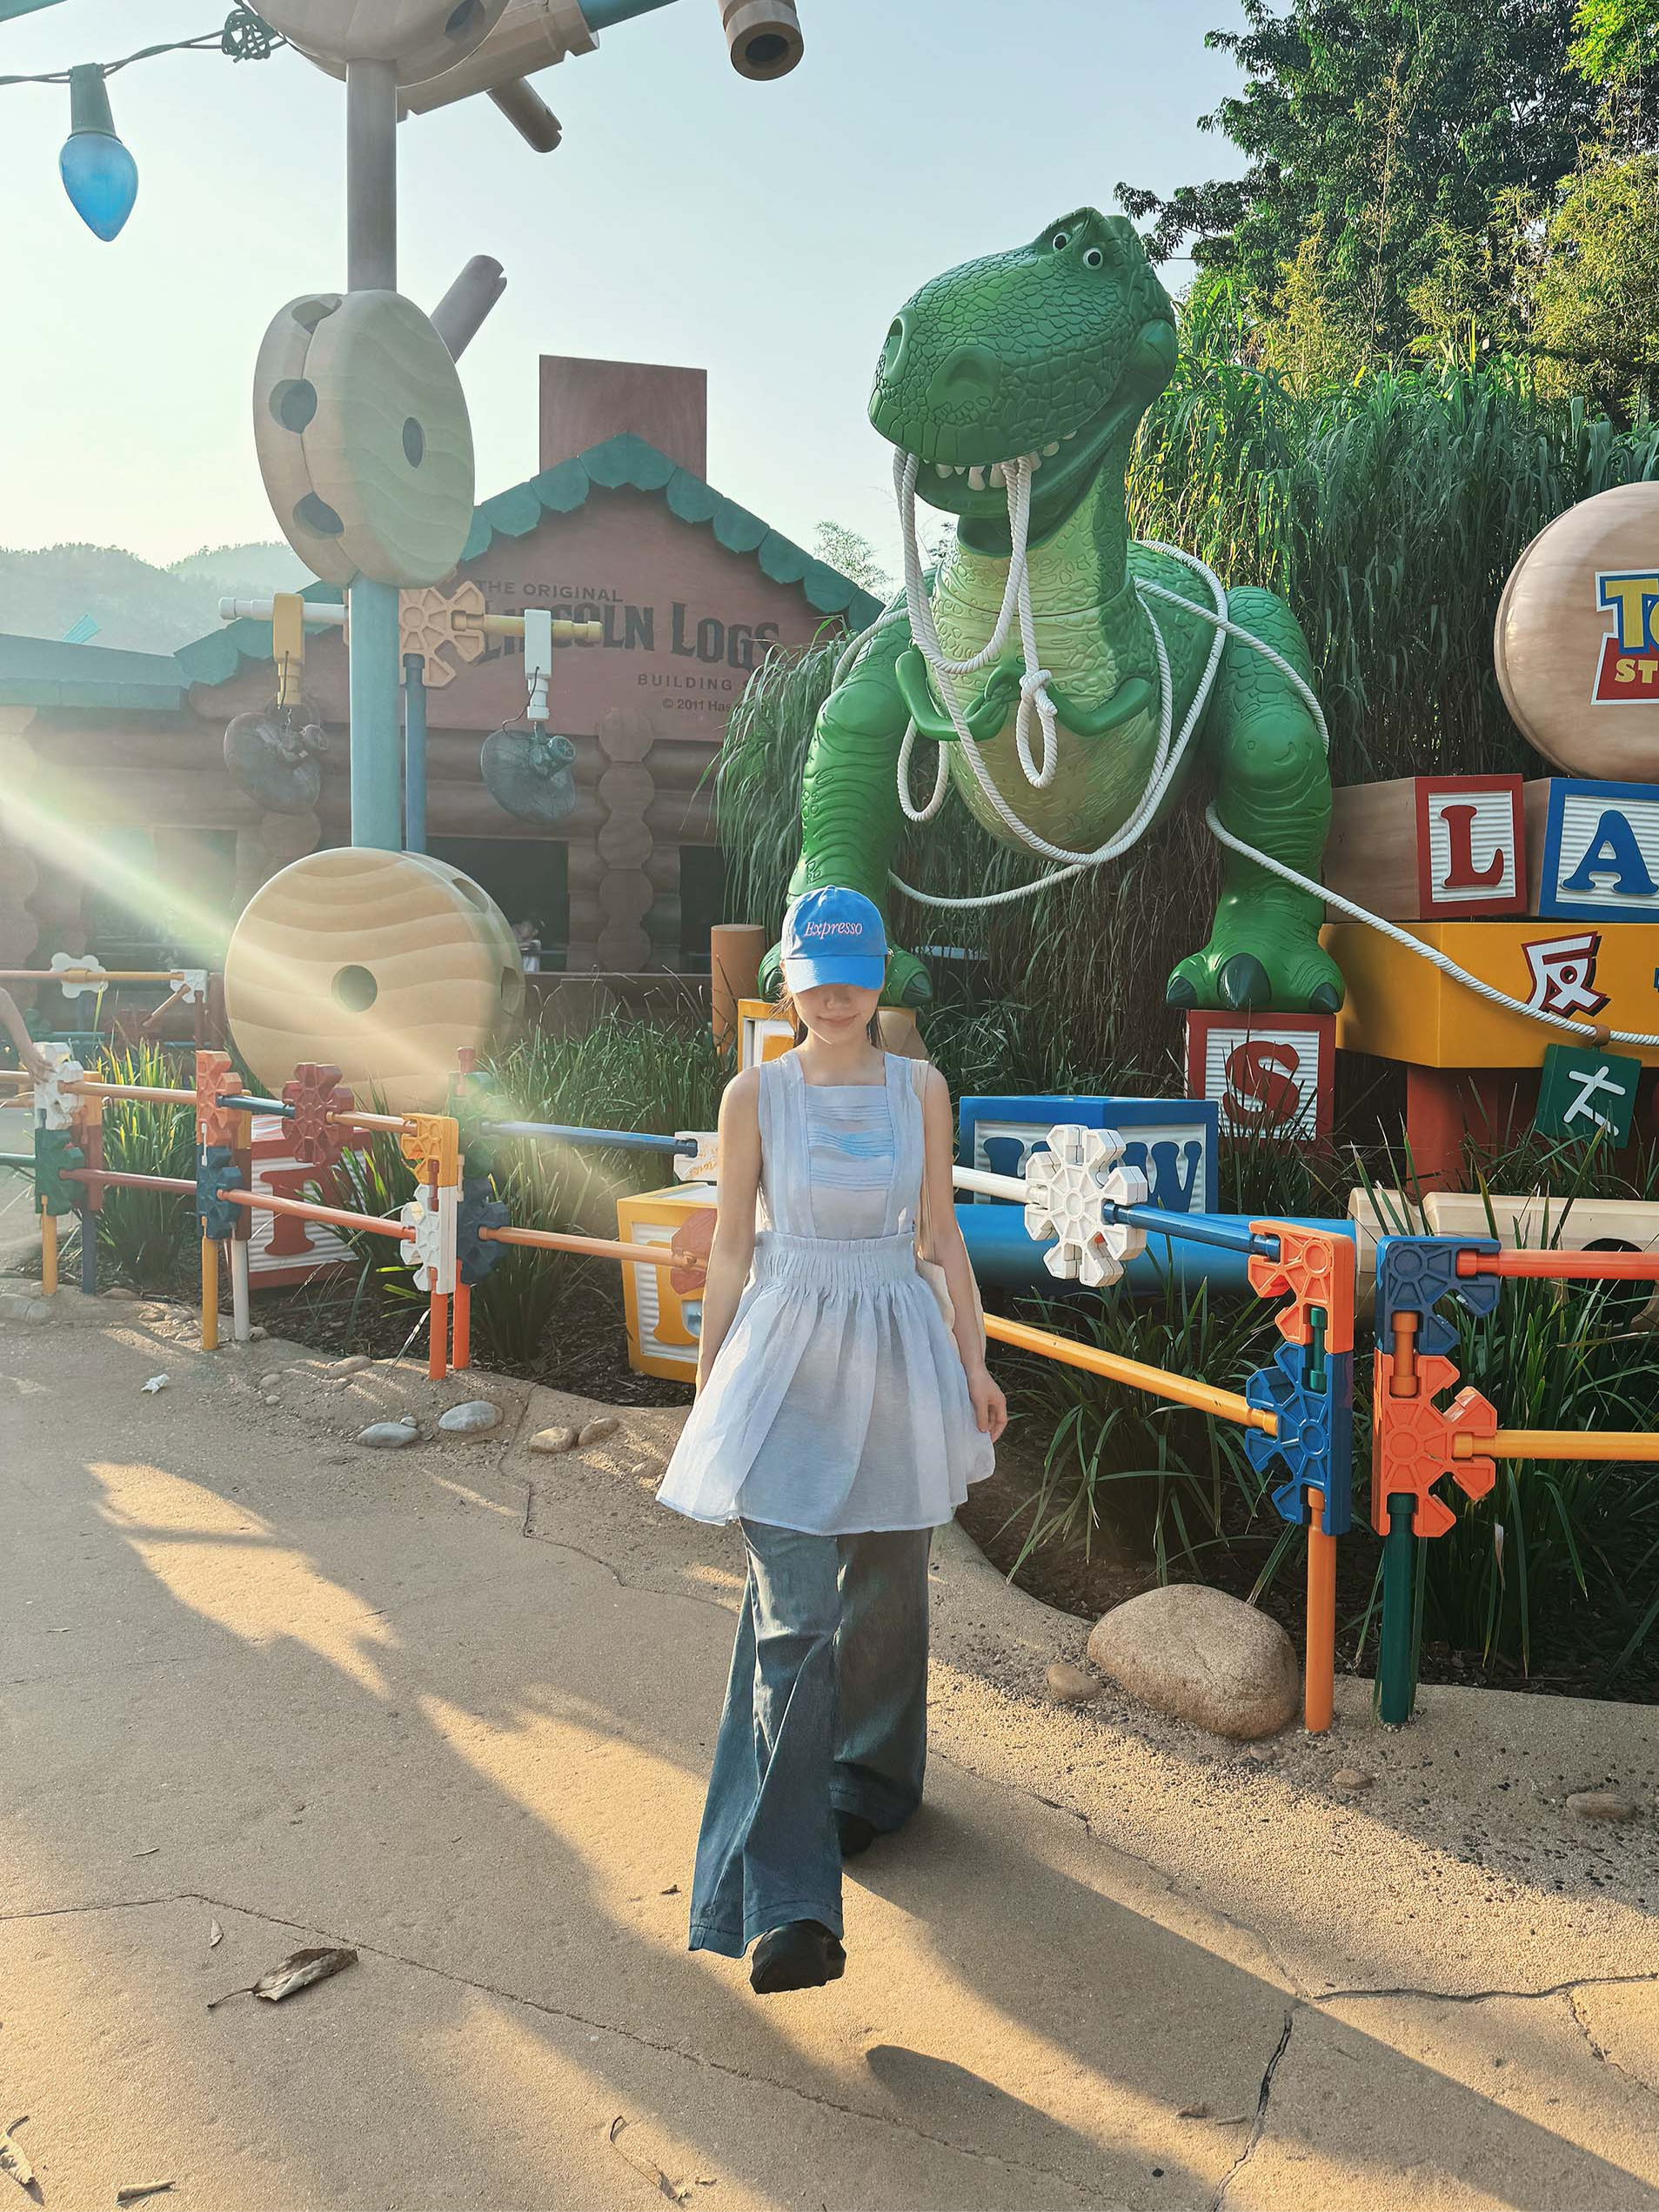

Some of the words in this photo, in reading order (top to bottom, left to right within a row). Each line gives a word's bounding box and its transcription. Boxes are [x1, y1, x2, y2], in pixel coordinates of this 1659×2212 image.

[478, 580, 515, 595] THE
[523, 583, 624, 603] ORIGINAL
[1605, 578, 1659, 648] T
[638, 673, 733, 692] BUILDING
[677, 698, 704, 711] 2011
[1440, 804, 1504, 888] L
[1562, 809, 1659, 896] A
[804, 920, 863, 940] Expresso
[1522, 932, 1610, 1019] 反
[1222, 1040, 1300, 1128] S
